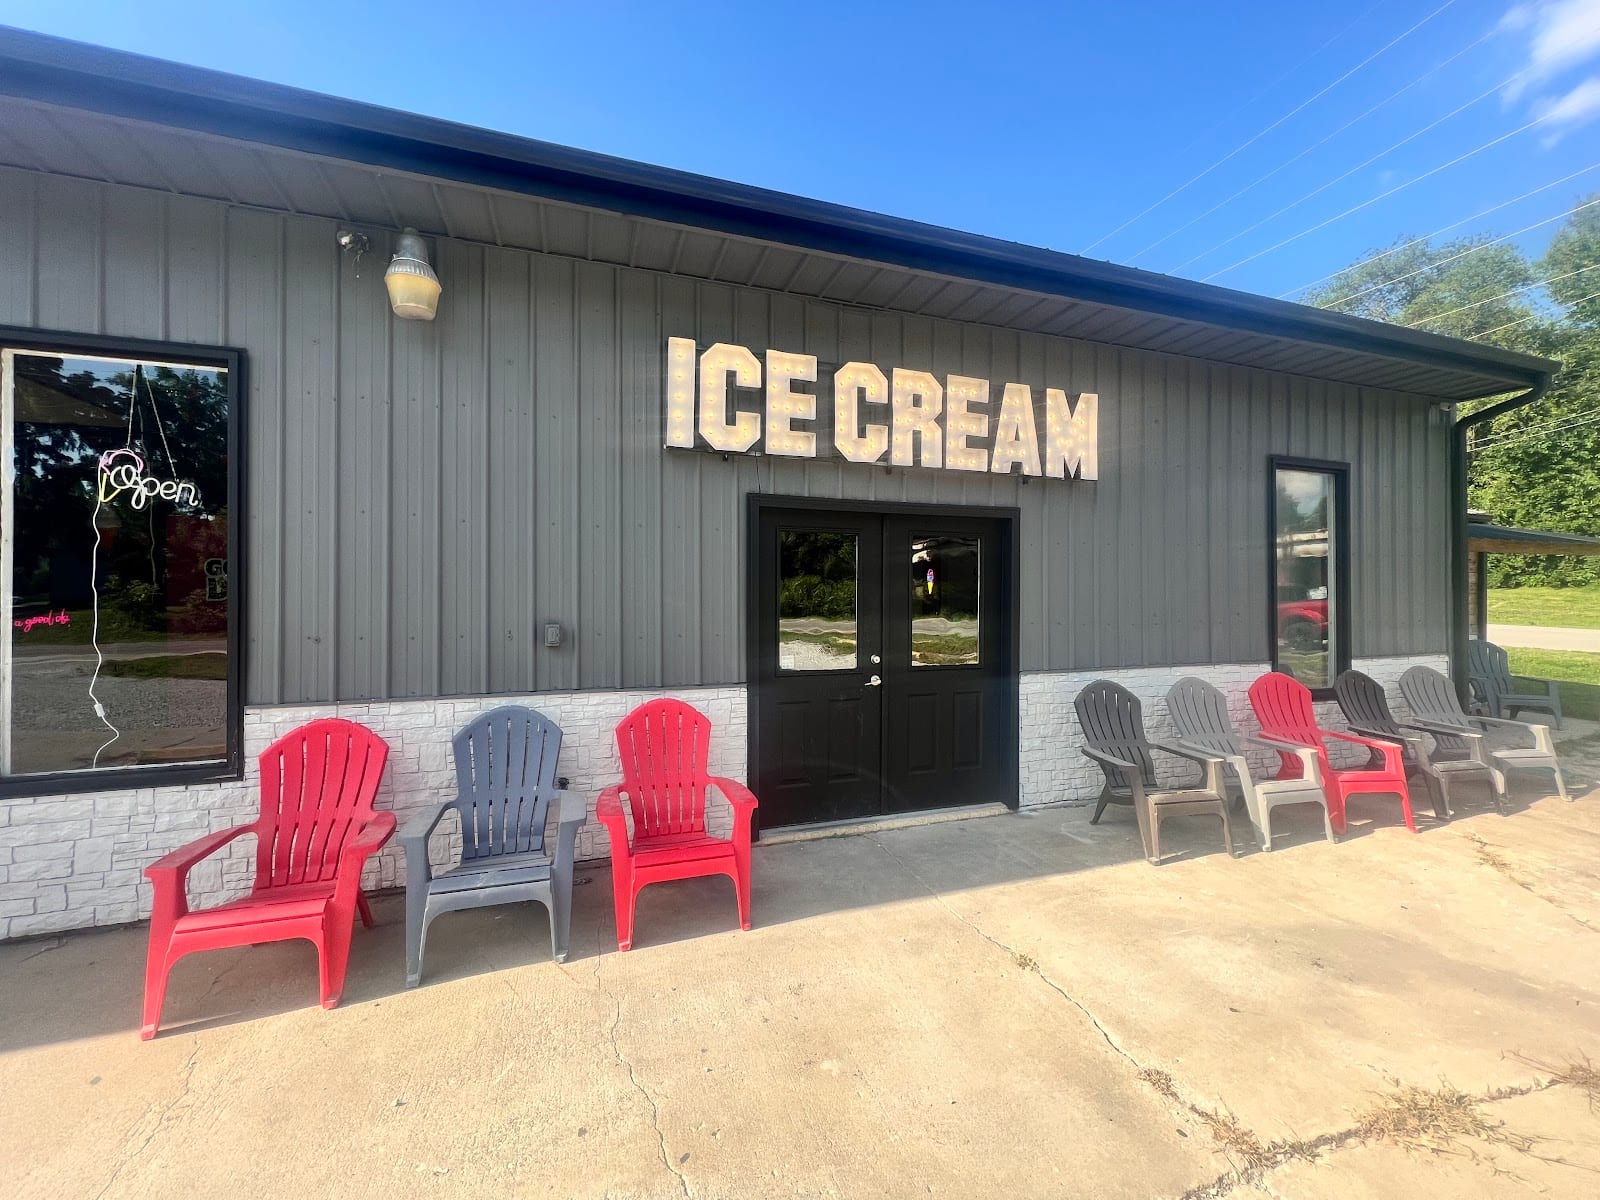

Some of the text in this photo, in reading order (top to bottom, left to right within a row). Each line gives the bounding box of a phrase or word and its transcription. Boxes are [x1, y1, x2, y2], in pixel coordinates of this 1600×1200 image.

[667, 336, 1099, 481] ICE CREAM
[109, 464, 199, 510] Open
[23, 609, 54, 633] good
